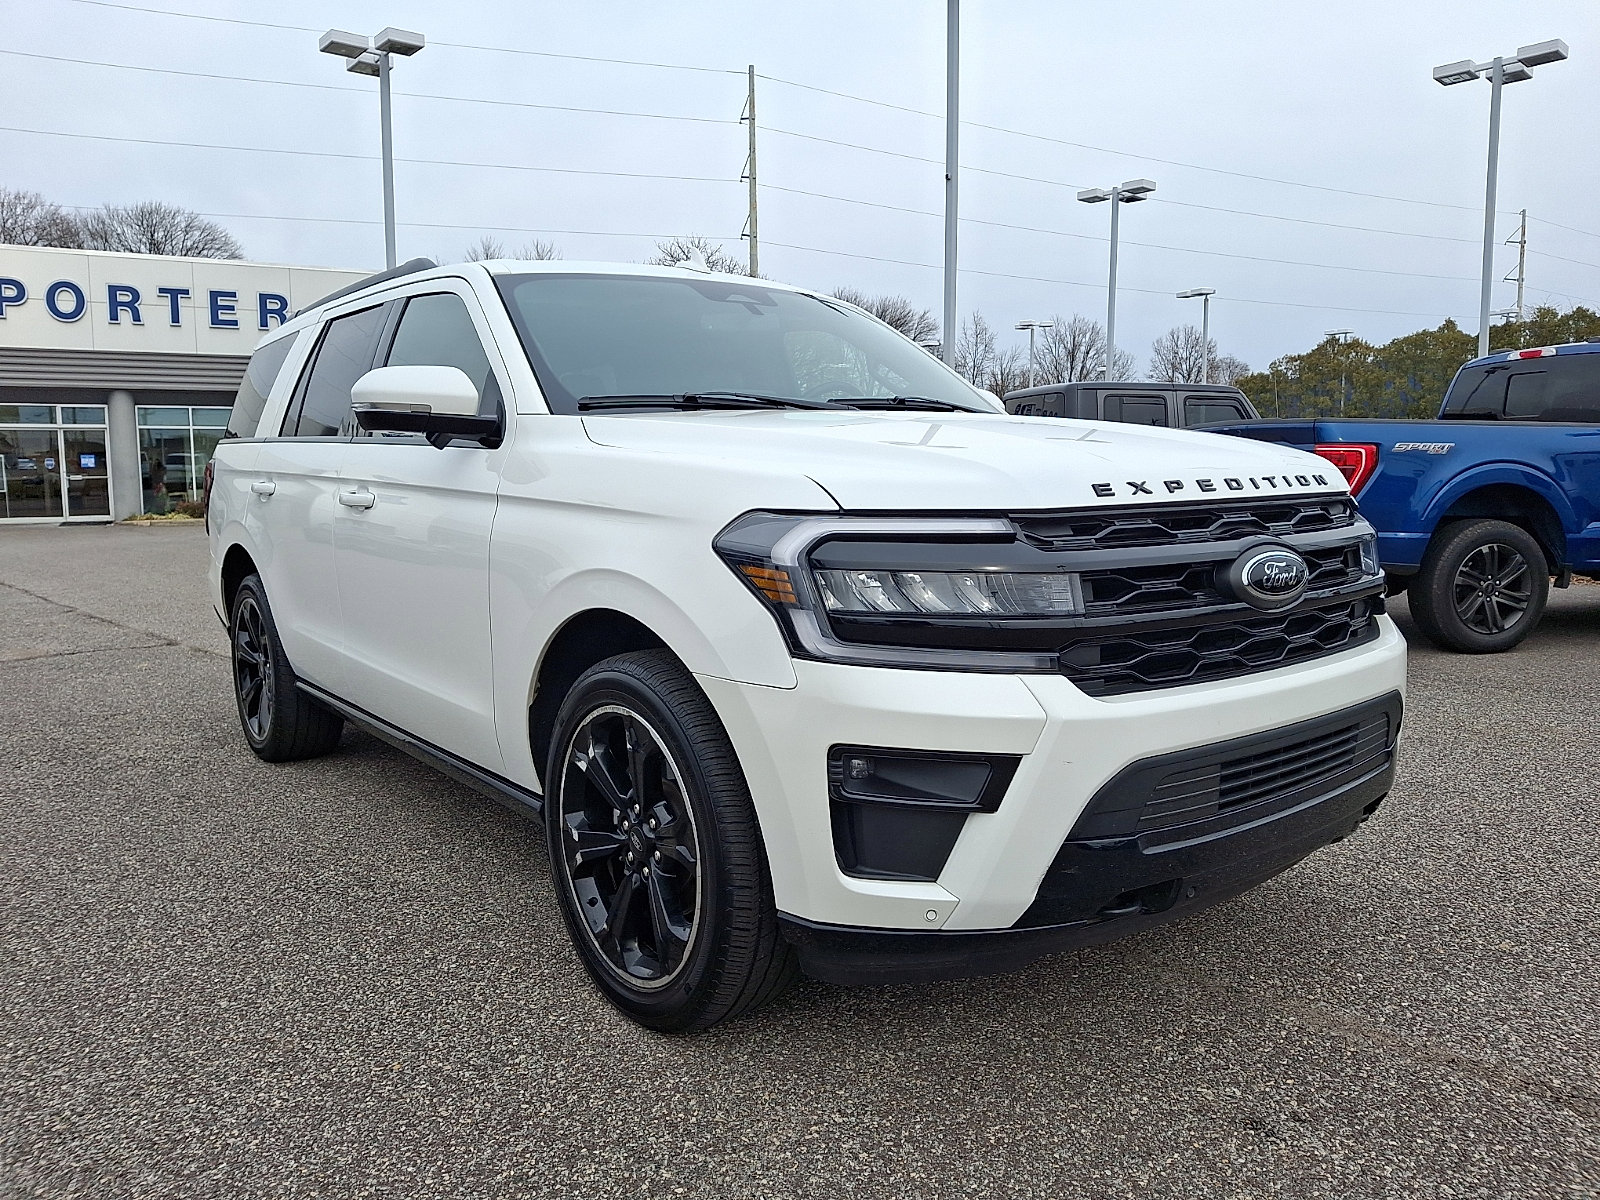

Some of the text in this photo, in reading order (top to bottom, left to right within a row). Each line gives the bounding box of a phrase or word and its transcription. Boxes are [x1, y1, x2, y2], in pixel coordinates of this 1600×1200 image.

[0, 276, 289, 330] PORTER
[1392, 442, 1456, 452] SPORT
[1091, 474, 1329, 498] EXPEDITION
[1263, 562, 1297, 588] Ford
